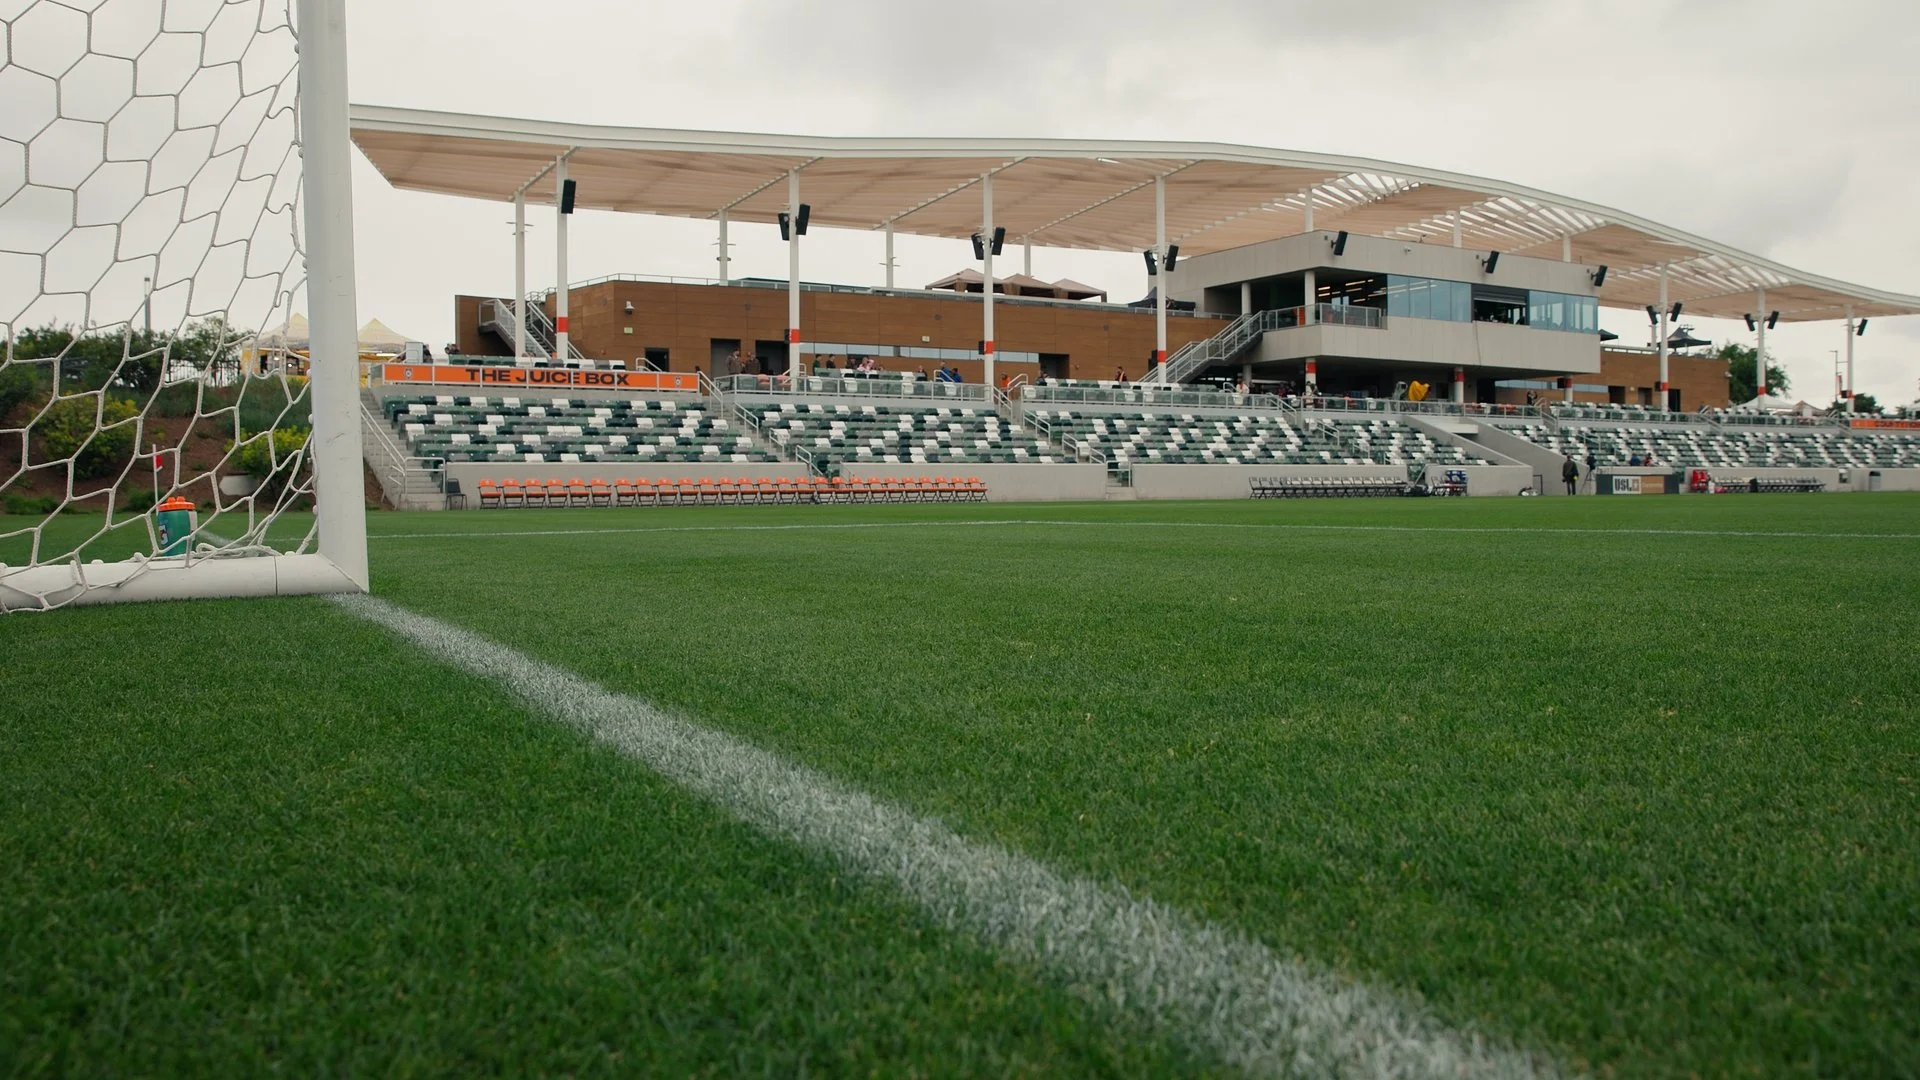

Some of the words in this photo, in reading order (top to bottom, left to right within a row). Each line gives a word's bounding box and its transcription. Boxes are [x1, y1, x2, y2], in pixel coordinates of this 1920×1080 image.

[465, 368, 511, 382] THE
[515, 369, 580, 385] JUICE
[585, 372, 630, 386] BOX
